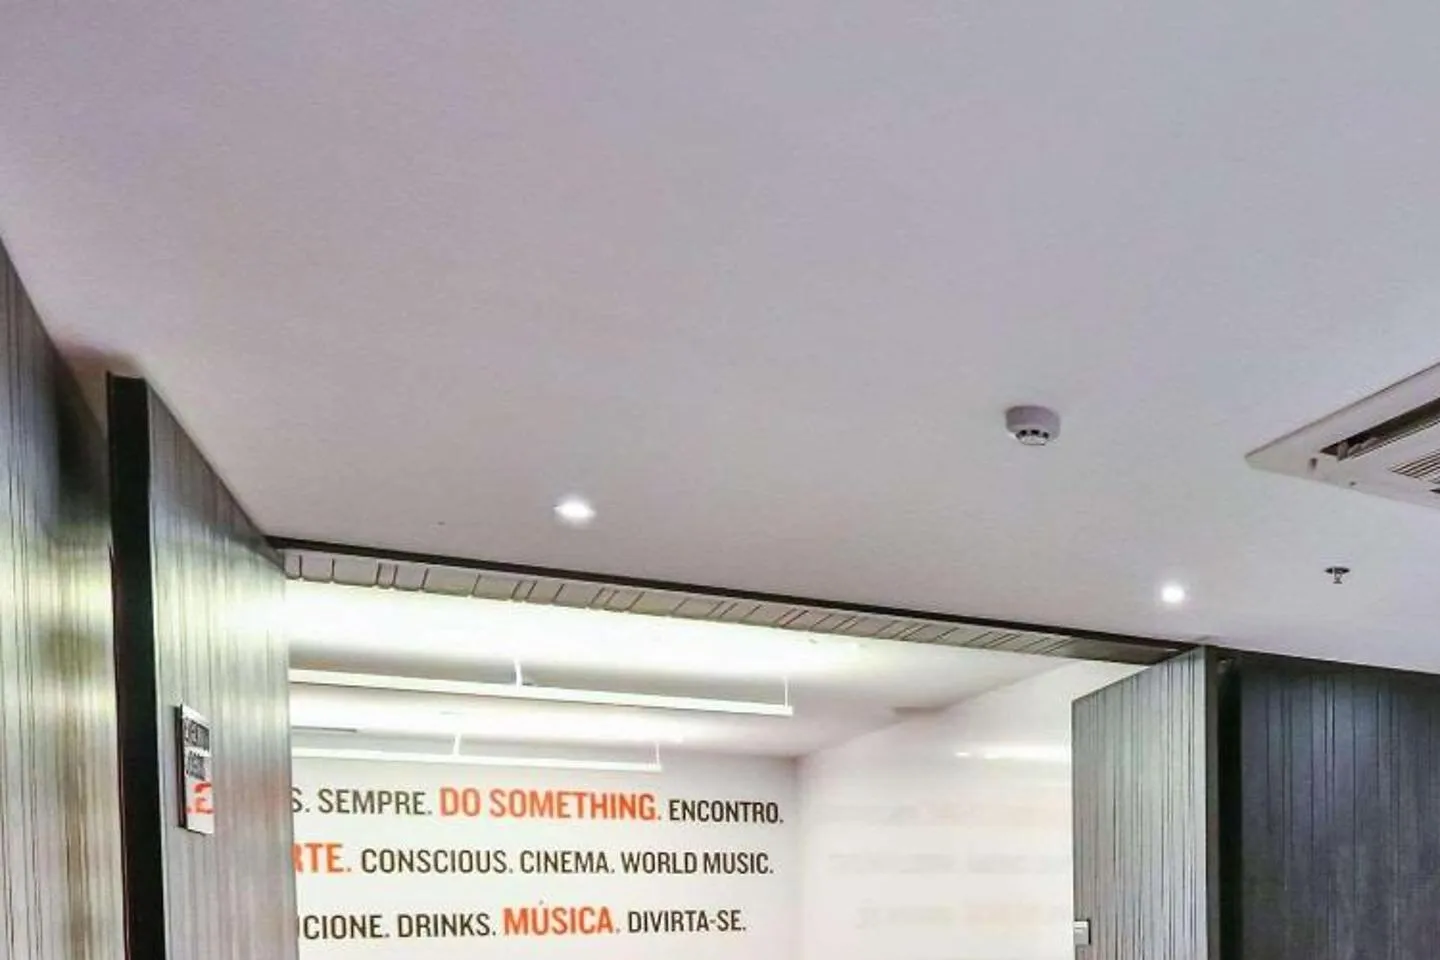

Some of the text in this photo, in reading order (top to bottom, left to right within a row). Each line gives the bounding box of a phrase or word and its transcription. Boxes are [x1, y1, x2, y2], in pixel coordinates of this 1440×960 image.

[318, 788, 432, 815] SEMPRE.
[440, 787, 481, 817] DO
[490, 789, 661, 821] SOMETHING.
[669, 799, 784, 824] ENCONTRO.
[361, 849, 513, 874] CONSCIOUS.
[520, 850, 615, 874] CINEMA.
[621, 852, 698, 874] WORLD
[703, 852, 774, 874] MUSIC.
[298, 914, 390, 940] CIONE.
[397, 913, 496, 938] DRINKS.
[628, 909, 747, 933] DIVIRTA-SE.
